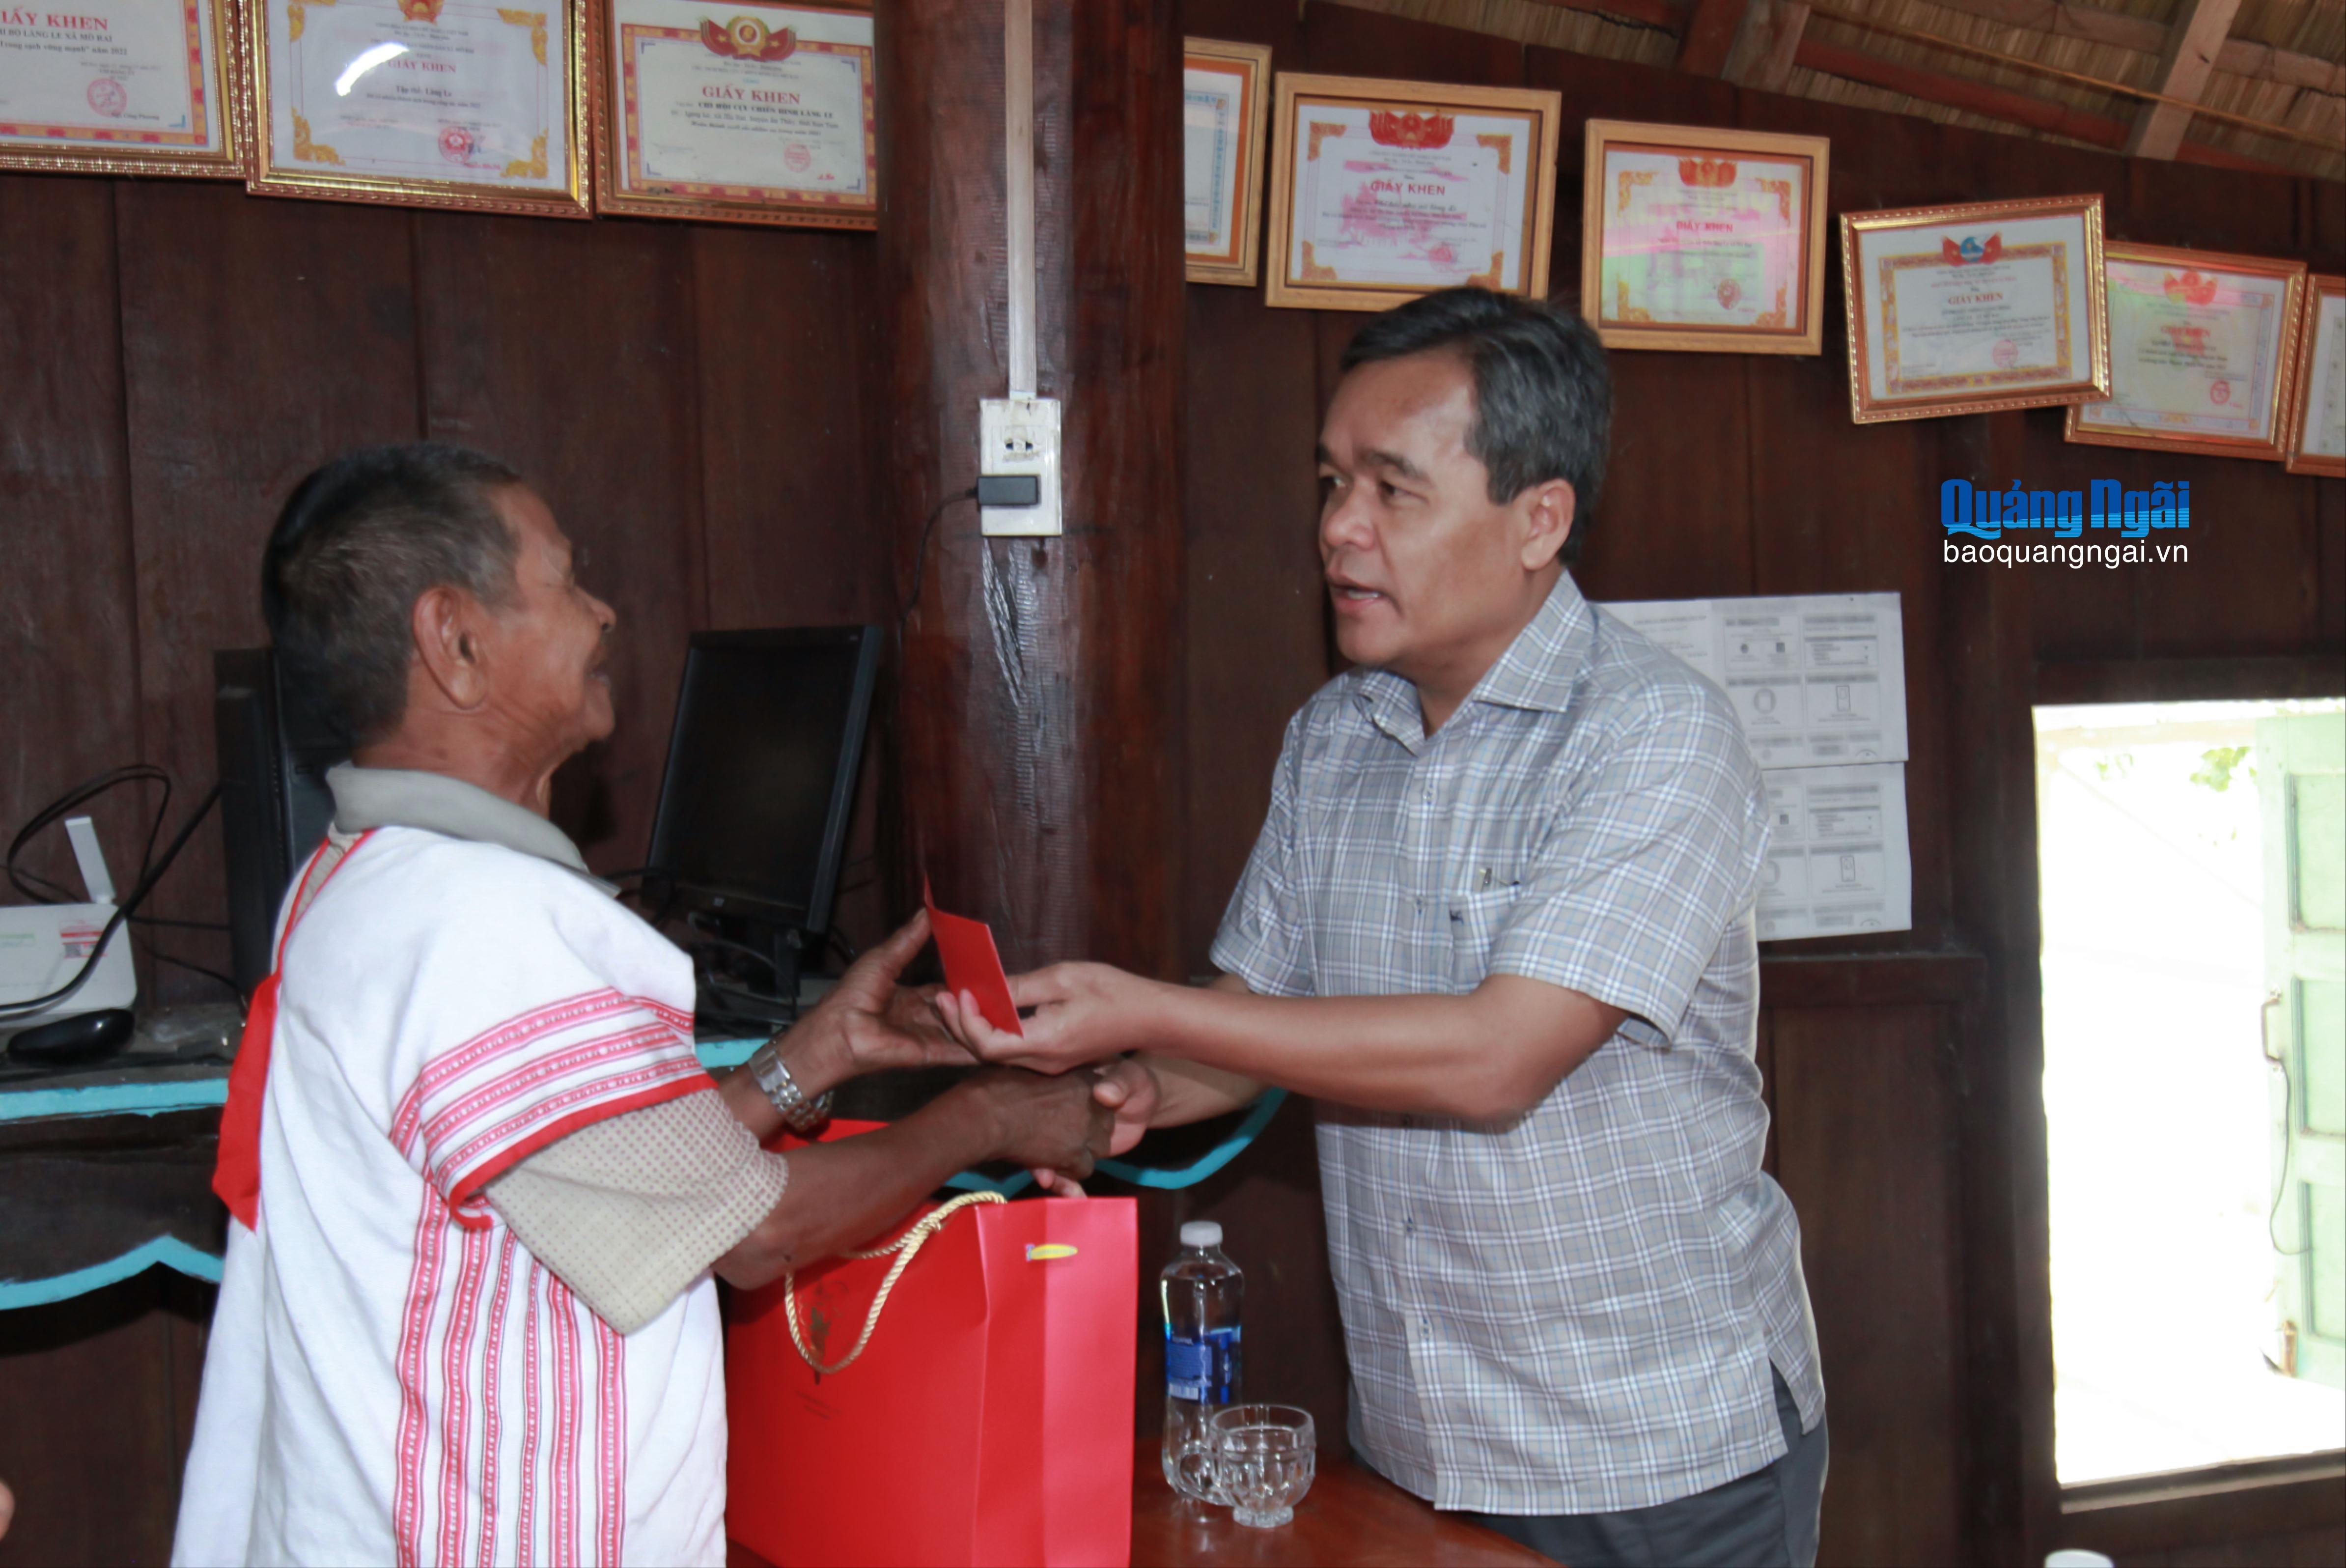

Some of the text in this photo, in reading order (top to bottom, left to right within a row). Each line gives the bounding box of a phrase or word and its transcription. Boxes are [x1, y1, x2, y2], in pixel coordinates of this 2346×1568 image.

[0, 7, 108, 31] IẤY KHEN
[421, 61, 456, 73] KHEN
[702, 83, 801, 105] GIẤY KHEN
[1408, 183, 1446, 196] KHEN
